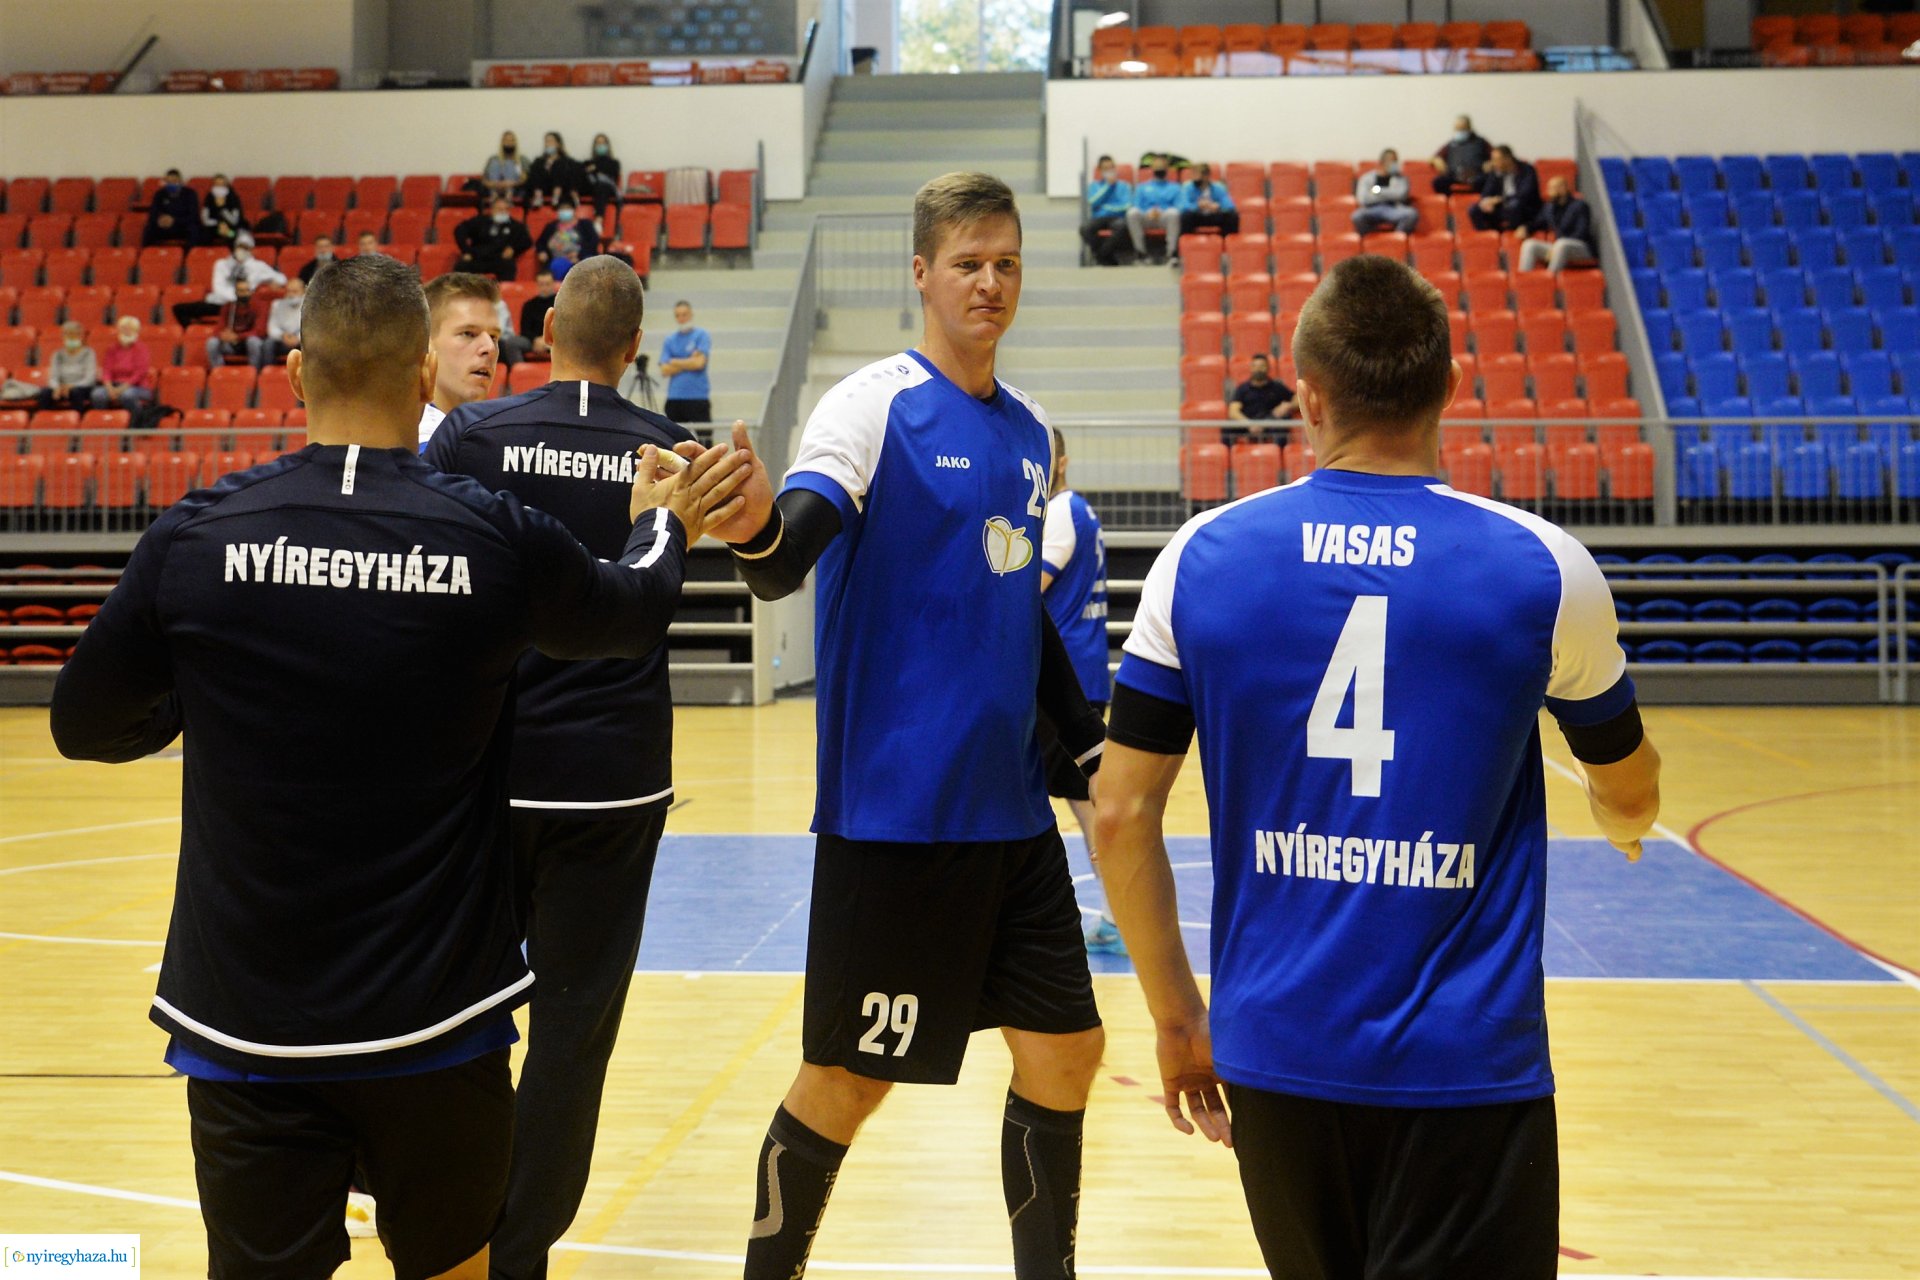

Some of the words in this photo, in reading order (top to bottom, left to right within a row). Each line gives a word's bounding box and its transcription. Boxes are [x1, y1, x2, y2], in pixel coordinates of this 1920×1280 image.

[503, 441, 642, 483] NYÍREGYHÁ
[936, 455, 971, 469] JAKO
[225, 536, 472, 594] NYÍREGYHÁZA
[1302, 522, 1417, 567] VASAS
[1306, 595, 1395, 797] 4
[1255, 823, 1475, 888] NYÍREGYHÁZA
[858, 991, 919, 1057] 29
